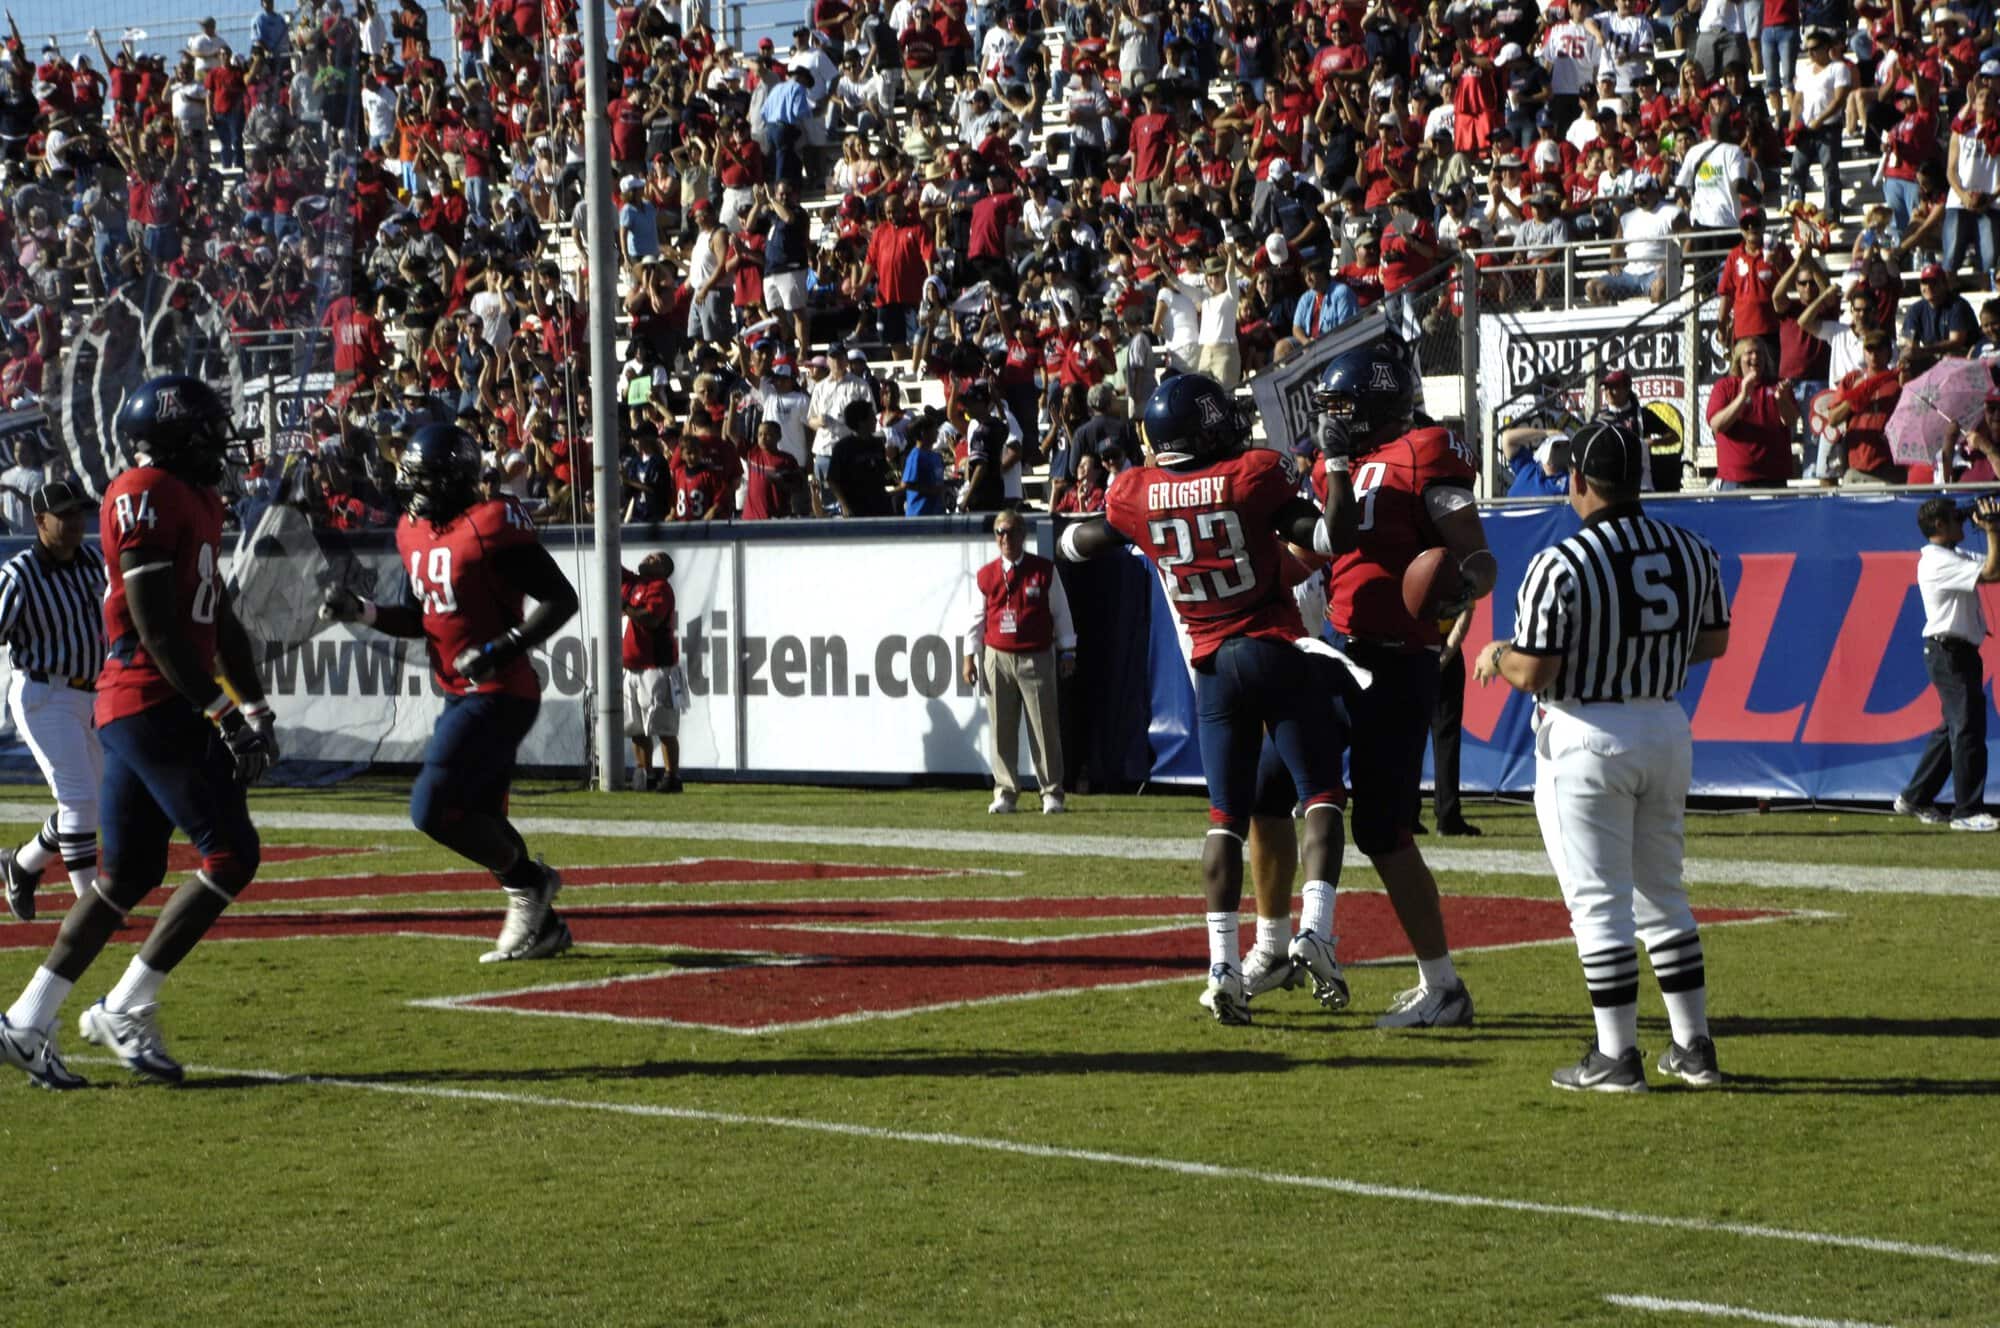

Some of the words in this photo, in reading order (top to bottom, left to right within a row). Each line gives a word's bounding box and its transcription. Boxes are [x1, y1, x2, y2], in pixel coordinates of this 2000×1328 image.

[1370, 362, 1399, 391] A
[1631, 380, 1676, 397] RESH
[115, 490, 158, 534] 84
[1147, 475, 1226, 511] GRIGSBY
[191, 542, 221, 624] 8
[410, 546, 458, 615] 49
[1147, 510, 1257, 602] 23
[1631, 553, 1680, 632] S
